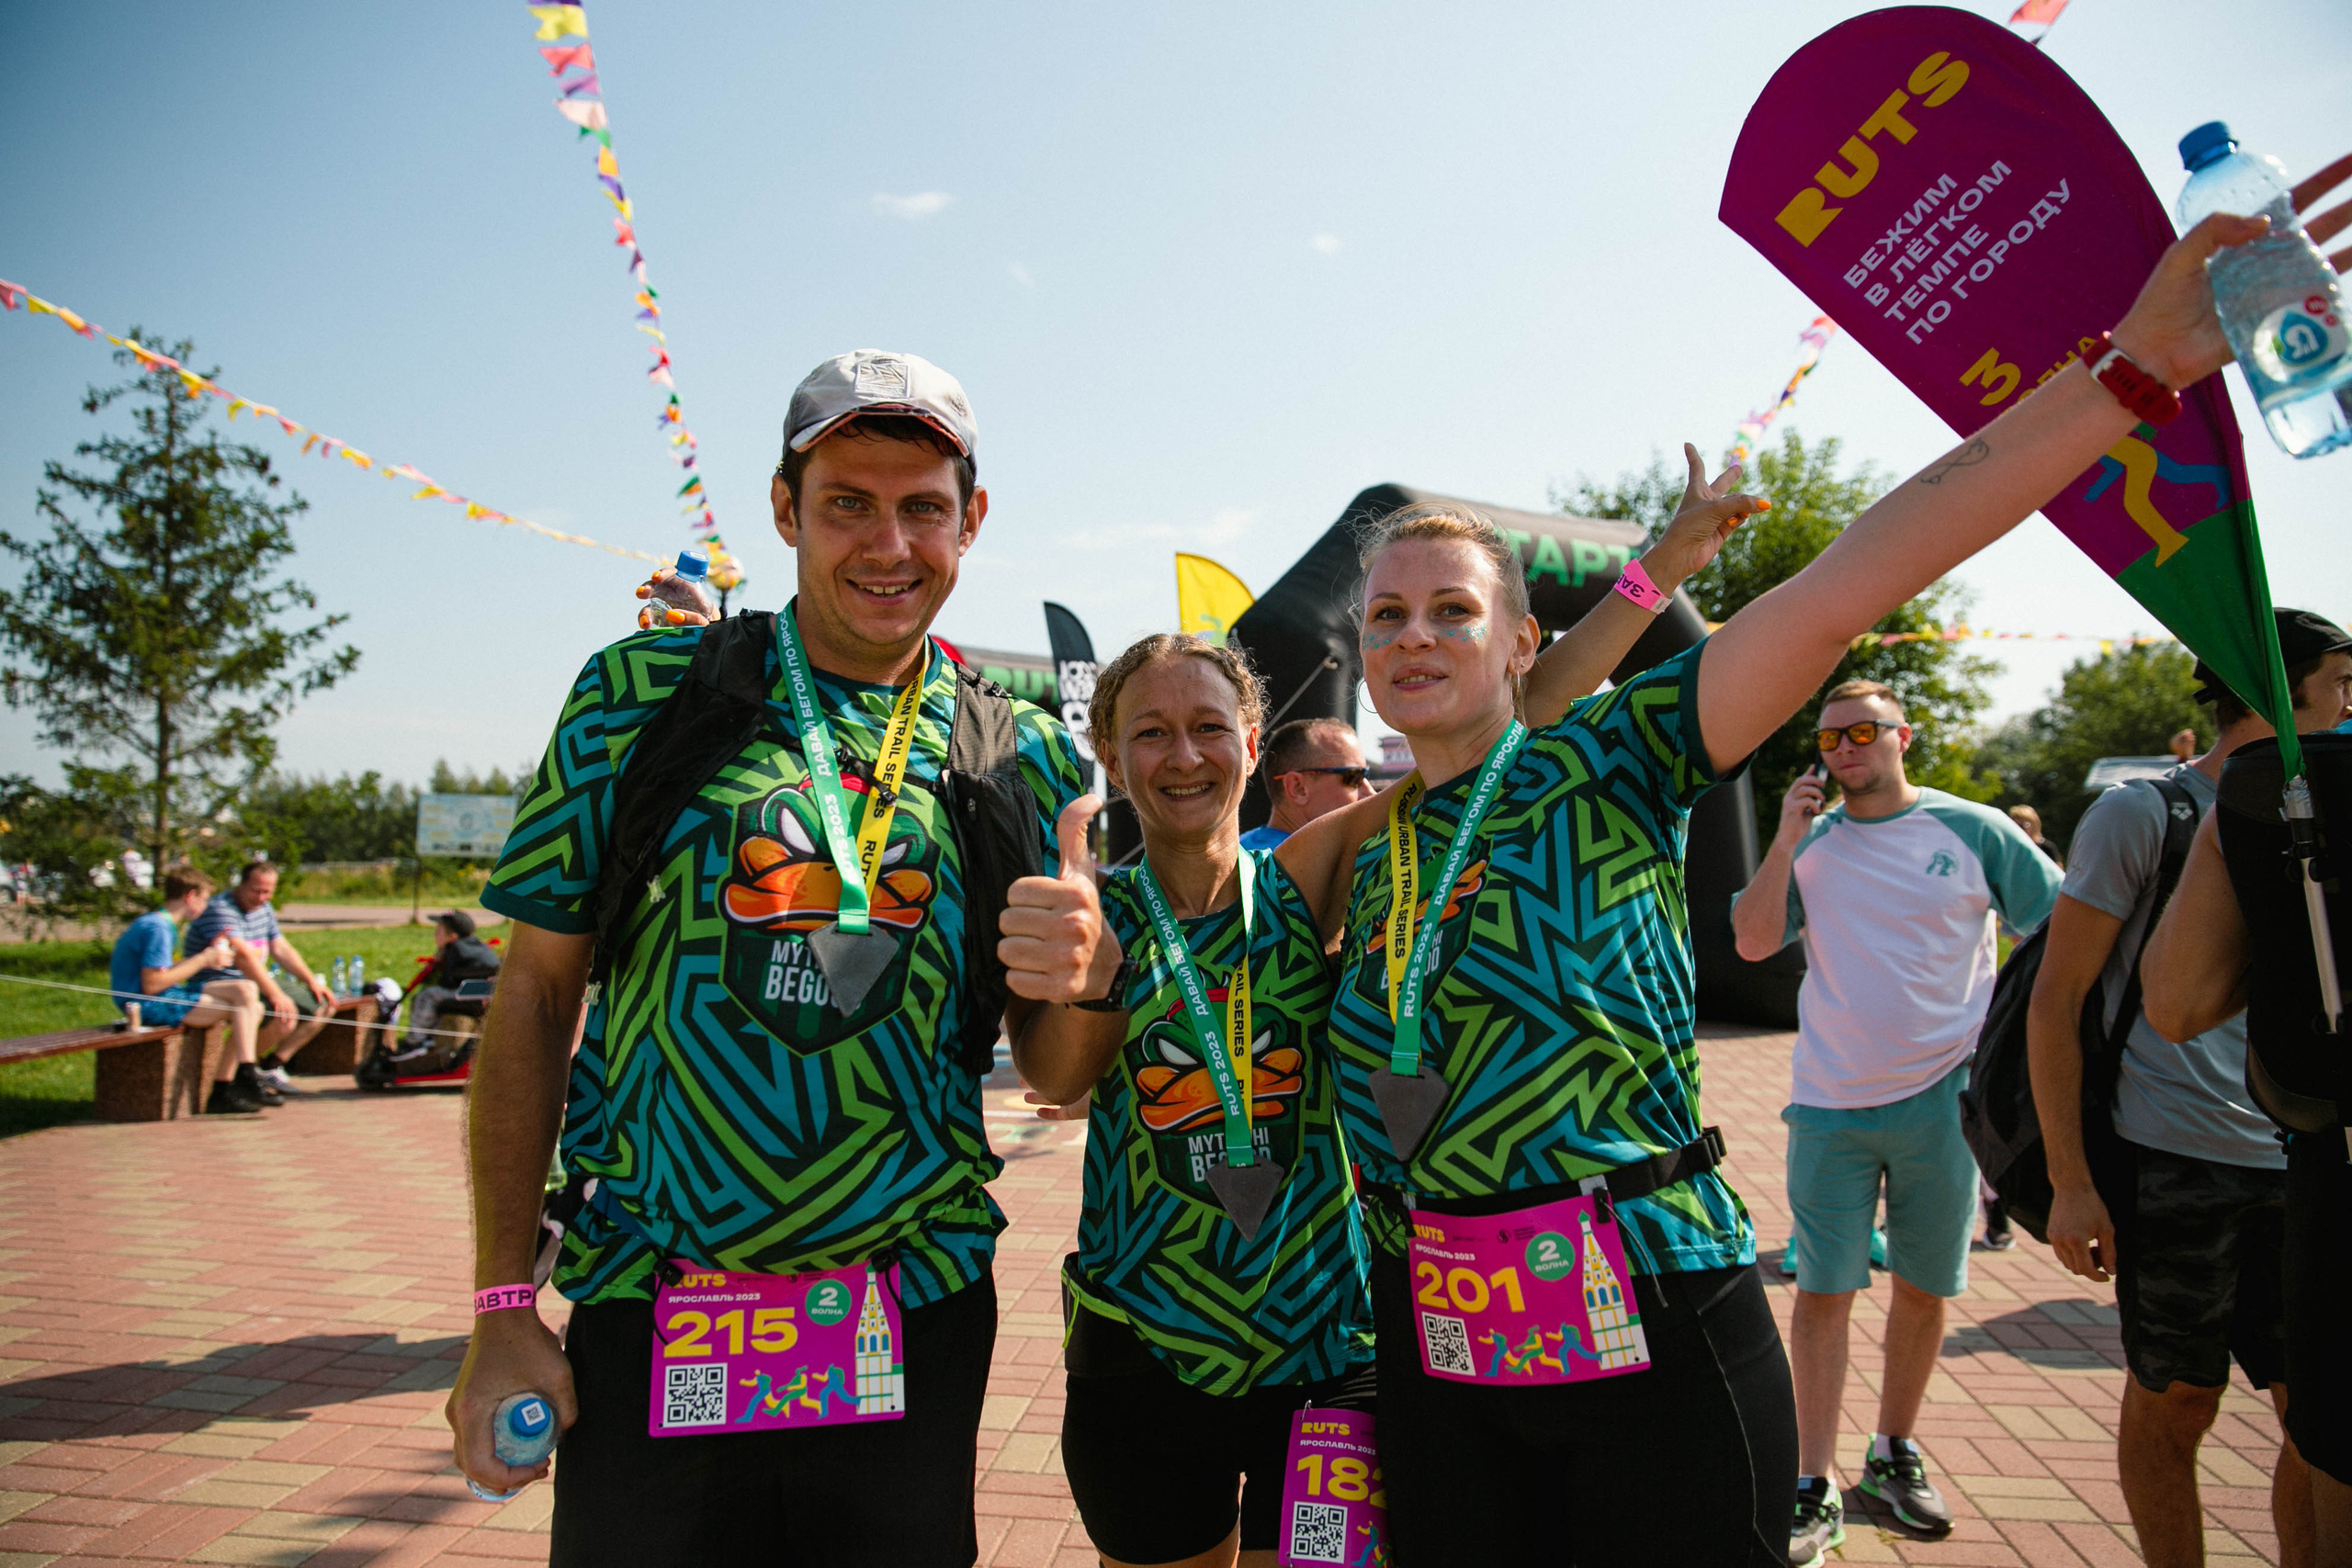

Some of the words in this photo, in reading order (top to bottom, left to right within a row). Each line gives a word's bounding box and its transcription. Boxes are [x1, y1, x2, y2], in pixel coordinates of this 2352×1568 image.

[1774, 51, 1970, 248] RUTS
[1843, 173, 1958, 288] БЕЖИМ
[1863, 282, 1890, 308] В
[1889, 160, 2012, 284] ЛЁГКОМ
[1883, 223, 1989, 321] ТЕМПЕ
[1905, 300, 1951, 345] ПО
[1951, 177, 2070, 299] ГОРОДУ
[1959, 347, 2021, 406] 3
[1492, 527, 1640, 588] ТАРТ
[780, 609, 794, 647] ЯРОС
[786, 648, 799, 667] ПО
[790, 669, 814, 718] БЕГОМ
[802, 721, 832, 777] ДАВАЙ
[888, 717, 910, 759] TRAIL
[874, 762, 897, 818] SEES
[824, 794, 845, 836] 2023
[1397, 826, 1411, 867] URBAN
[1400, 869, 1412, 908] TRAIL
[1404, 967, 1420, 1018] RUTS
[1414, 922, 1432, 964] 2023
[1434, 850, 1462, 906] ДАВАЙ
[1457, 795, 1486, 846] БЕГОМ
[1480, 772, 1498, 792] ПО
[1491, 720, 1525, 770] ЯРОСЛА
[1151, 900, 1166, 918] ПО
[1159, 919, 1186, 964] БЕГОМ
[1395, 908, 1408, 959] SERIES
[764, 964, 861, 1009] BEGO
[1178, 966, 1209, 1016] ДАВАЙ
[1234, 998, 1244, 1057] SERIES
[1205, 1031, 1227, 1070] 2023
[1219, 1075, 1240, 1117] RUTS
[1413, 1224, 1446, 1244] RUTS
[1415, 1244, 1453, 1259] ЯРОСЛАВЛЬ
[1454, 1252, 1476, 1261] 2023
[1538, 1240, 1560, 1262] 2
[668, 1273, 726, 1288] UTS
[1535, 1258, 1569, 1273] ВОЛНА
[668, 1293, 734, 1303] ЯРОСЛАВЛЬ
[735, 1292, 761, 1302] 2023
[818, 1286, 838, 1306] 2
[1416, 1261, 1525, 1314] 201
[663, 1306, 798, 1358] 215
[811, 1307, 843, 1316] ВОЛНА
[1300, 1439, 1356, 1450] ЯРОСЛАВЛЬ
[1357, 1445, 1376, 1456] 2023
[1301, 1422, 1351, 1436] RUTS
